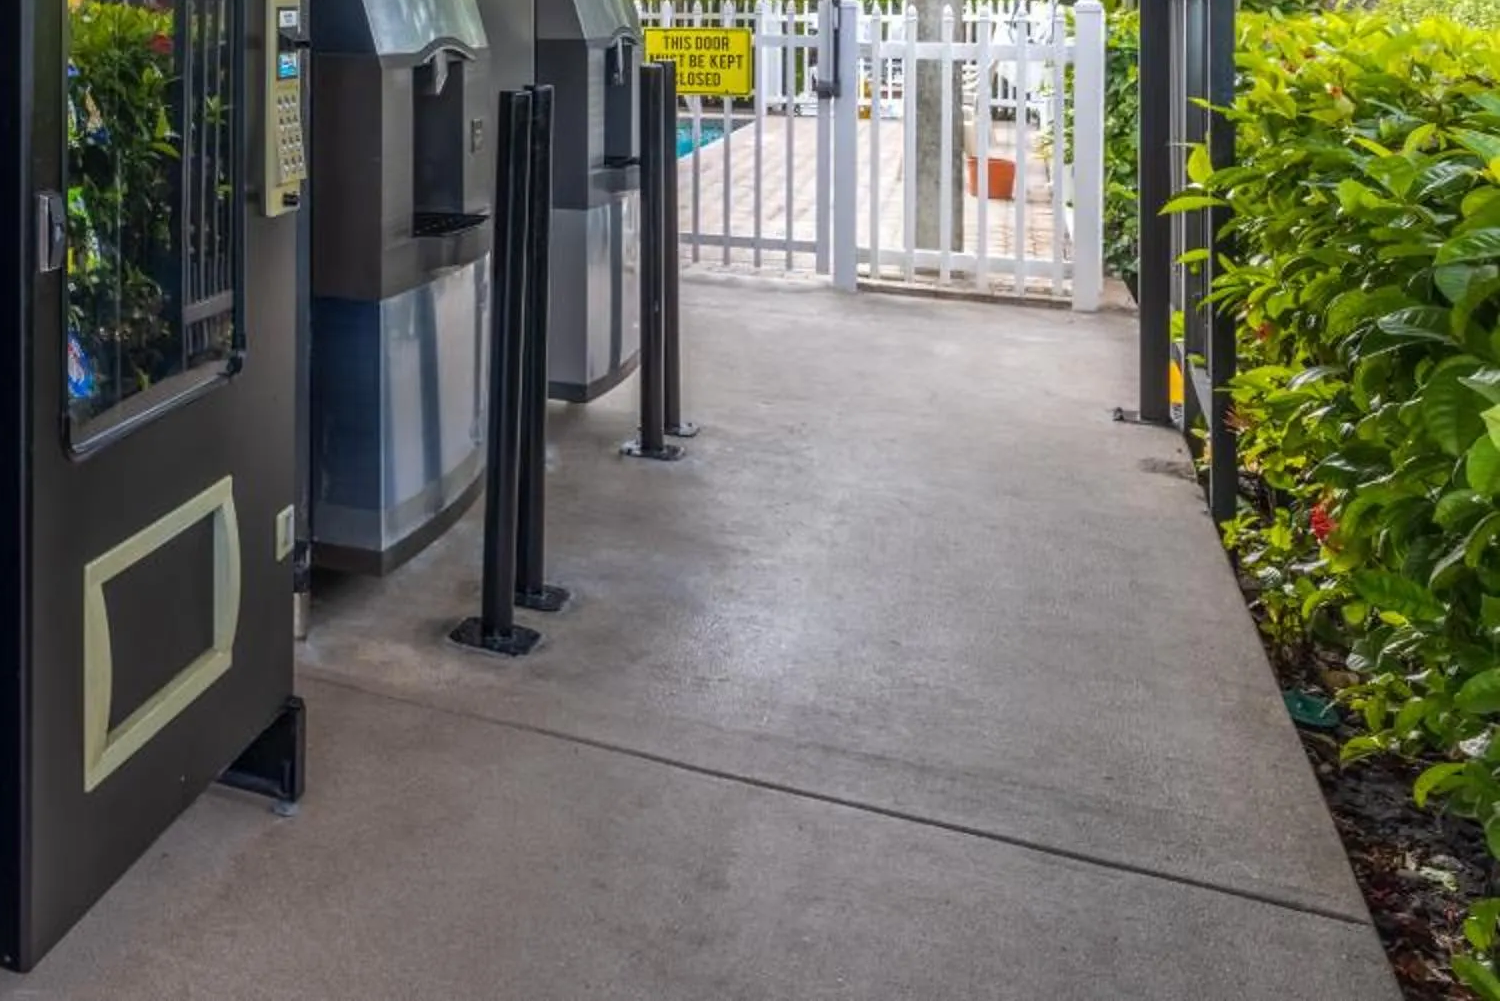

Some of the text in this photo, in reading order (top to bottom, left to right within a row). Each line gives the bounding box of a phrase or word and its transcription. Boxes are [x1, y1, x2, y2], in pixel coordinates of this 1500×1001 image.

[663, 35, 729, 52] THIS DOOR
[689, 54, 706, 68] BE
[709, 54, 744, 70] KEPT
[677, 71, 721, 87] LOSED
